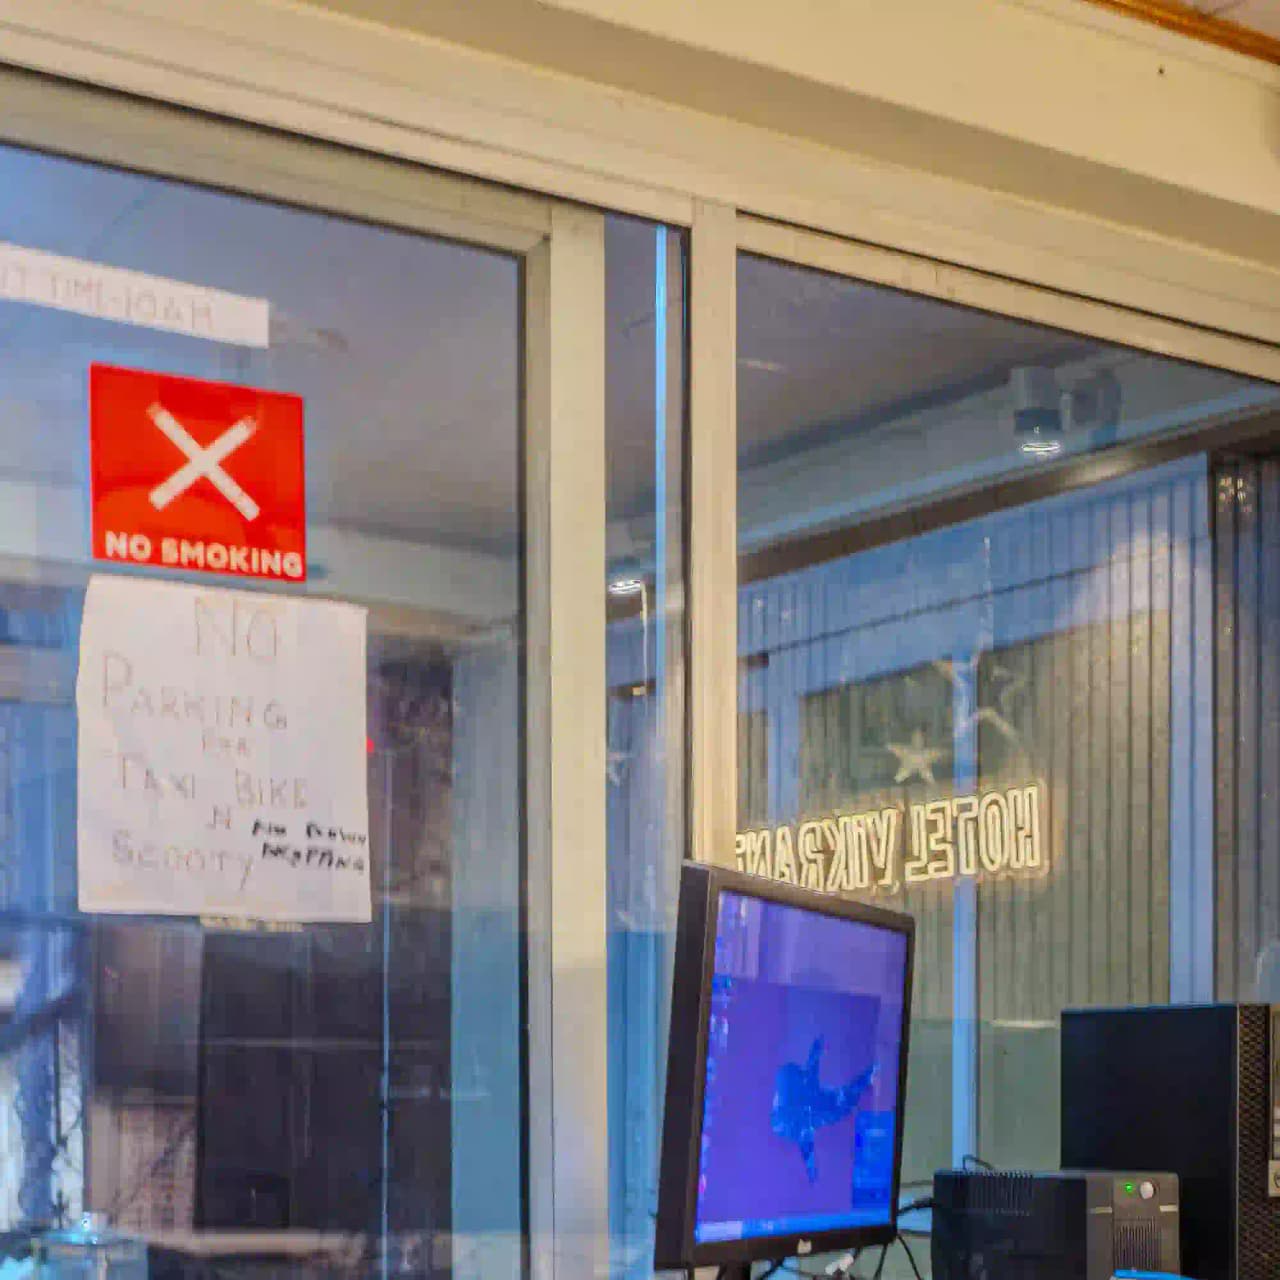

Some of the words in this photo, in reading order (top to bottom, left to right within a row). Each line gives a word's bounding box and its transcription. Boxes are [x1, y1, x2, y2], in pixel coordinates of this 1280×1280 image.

[105, 530, 152, 561] NO
[161, 537, 304, 578] SMOKING
[194, 599, 280, 663] NO
[103, 653, 288, 739] PARKING
[235, 767, 308, 810] BIKE
